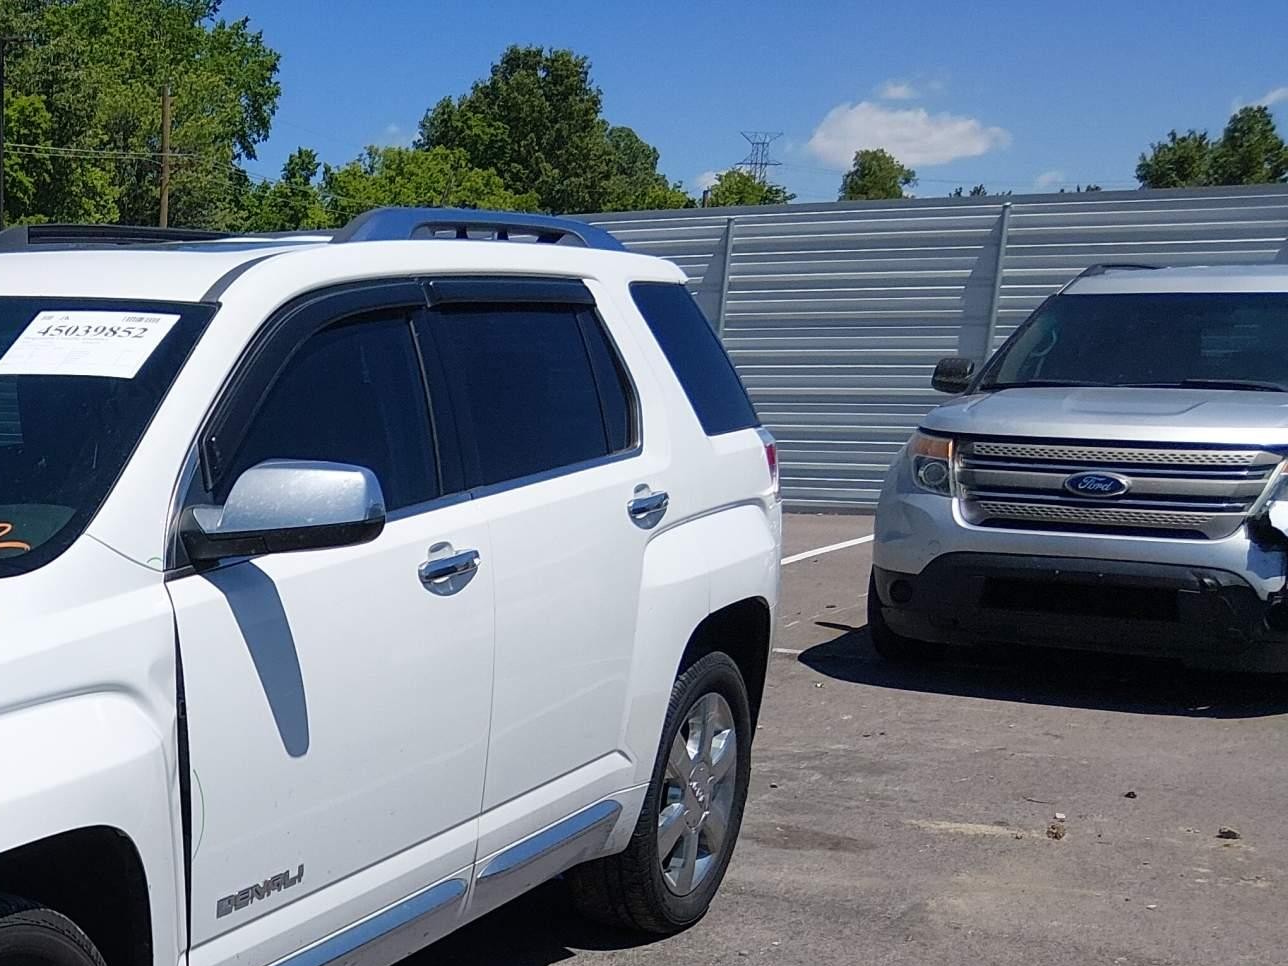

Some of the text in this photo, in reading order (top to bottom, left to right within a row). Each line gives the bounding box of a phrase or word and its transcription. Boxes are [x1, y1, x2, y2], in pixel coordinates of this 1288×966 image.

[37, 325, 149, 339] 45039852
[1078, 476, 1114, 491] Ford
[215, 863, 304, 919] DENALI
